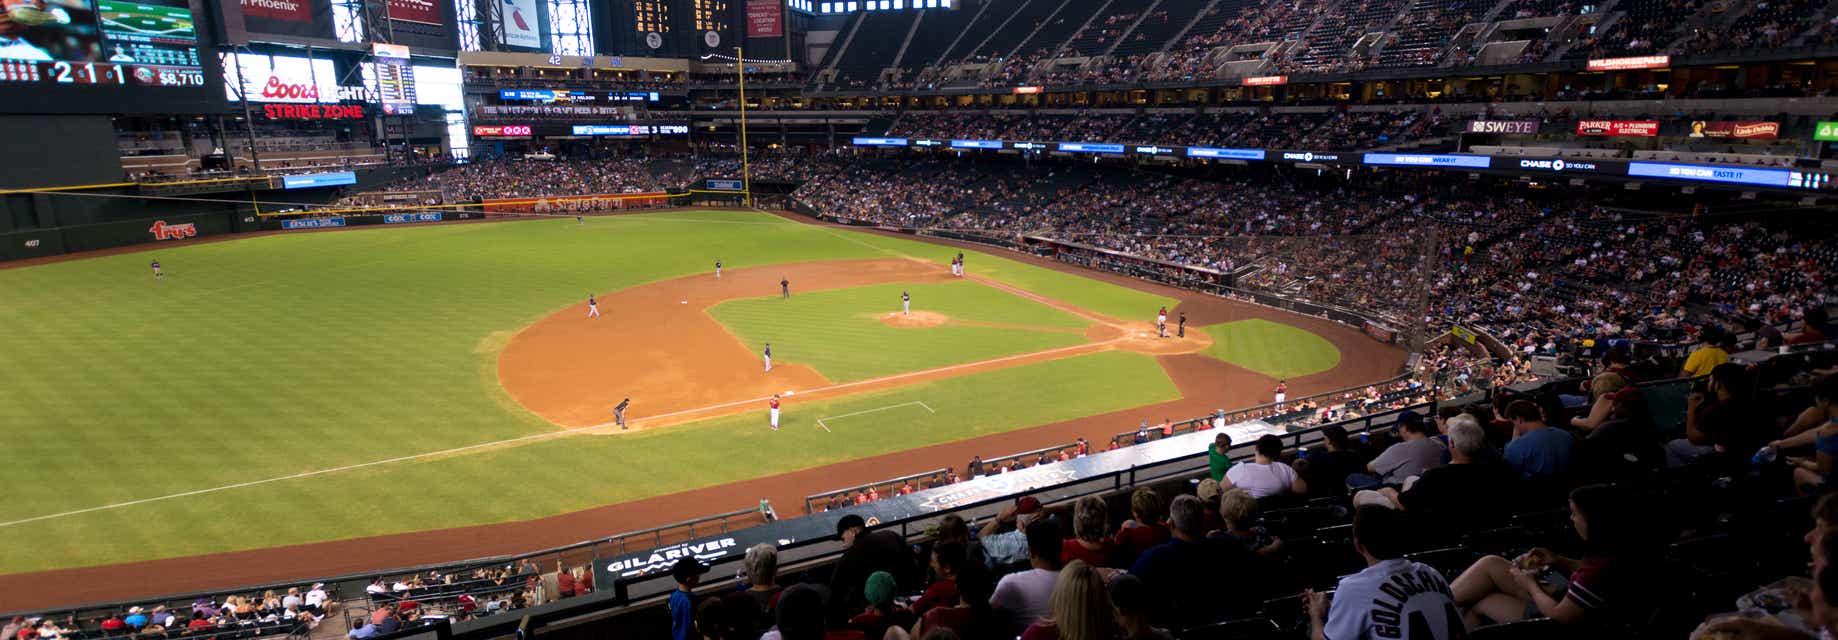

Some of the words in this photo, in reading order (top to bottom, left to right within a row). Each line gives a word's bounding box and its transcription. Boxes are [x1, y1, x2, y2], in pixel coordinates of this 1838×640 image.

[251, 0, 296, 11] Phoenix
[548, 56, 561, 66] 42
[55, 61, 74, 82] 2
[85, 63, 97, 83] 1
[113, 64, 125, 84] 1
[160, 72, 204, 85] $8,710
[263, 76, 318, 98] Coors
[264, 104, 321, 118] STRIKE
[323, 105, 363, 118] ZONE
[1486, 121, 1532, 133] SWEYE
[1580, 121, 1611, 131] PARKER
[1520, 160, 1552, 168] CHASE
[1713, 170, 1734, 178] TASTE
[150, 221, 196, 239] fry's
[607, 555, 672, 573] GILA
